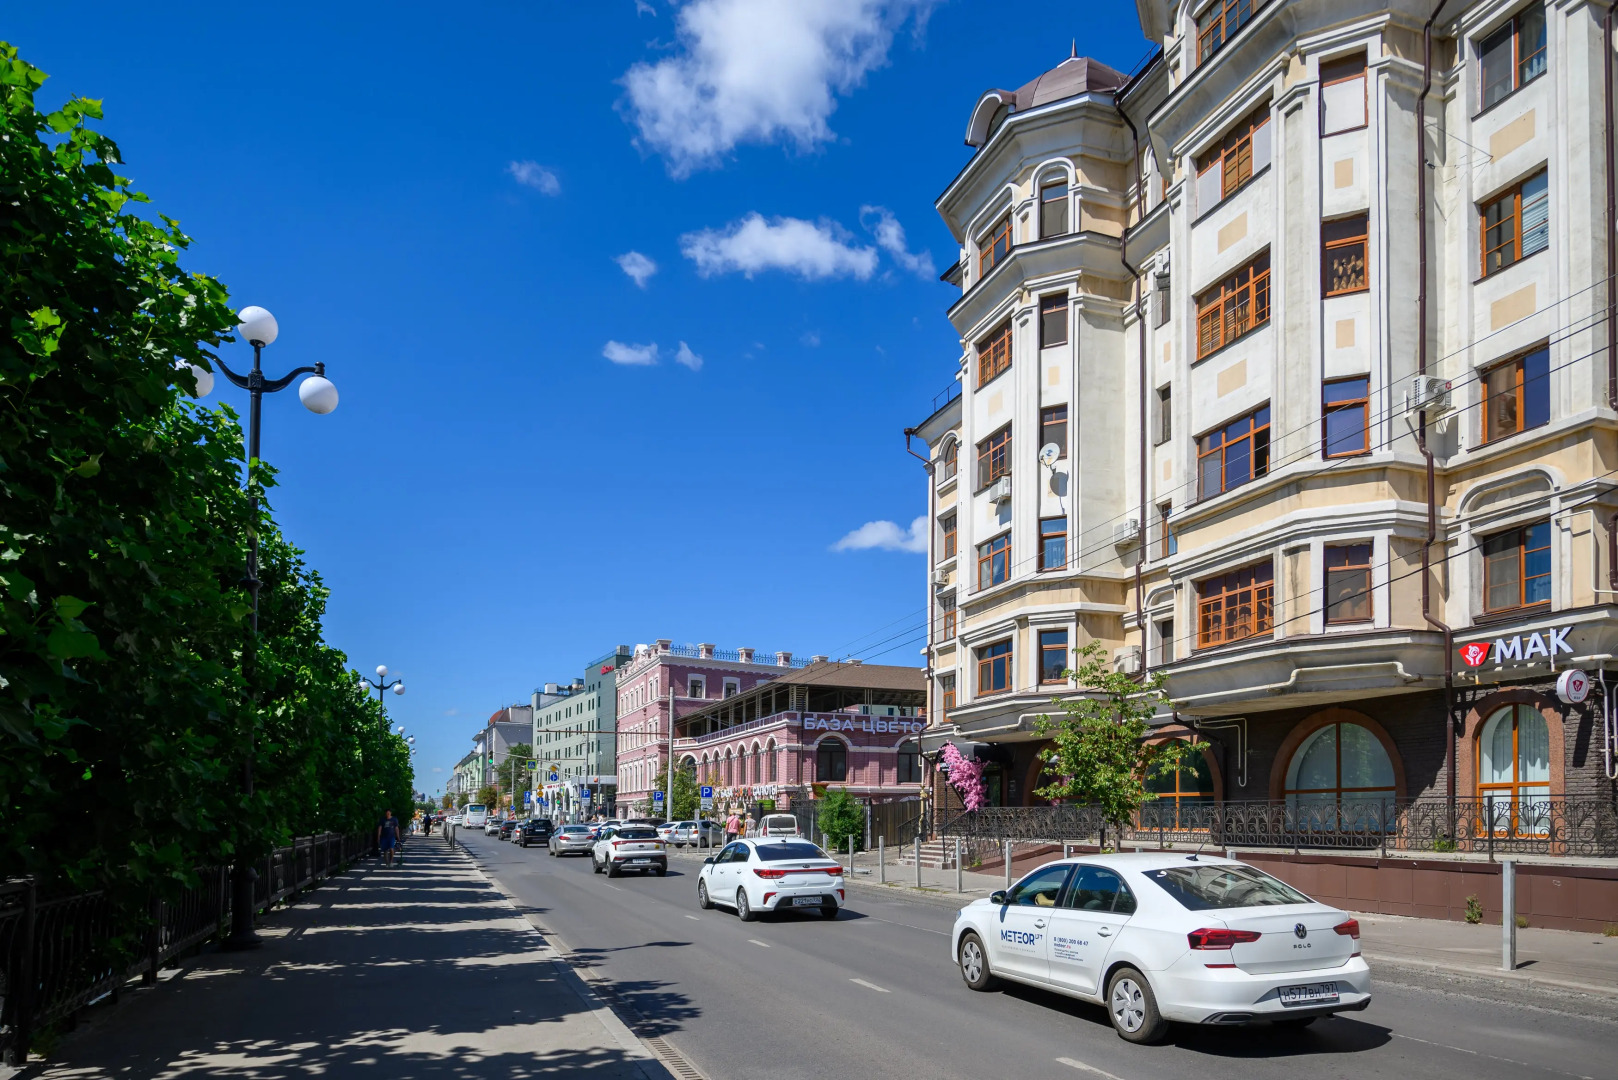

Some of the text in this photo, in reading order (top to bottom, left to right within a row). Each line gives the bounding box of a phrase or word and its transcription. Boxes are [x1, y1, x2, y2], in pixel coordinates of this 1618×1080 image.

[1495, 626, 1574, 664] МАК
[804, 717, 926, 734] БАЗА ЦВЕТО
[1001, 930, 1035, 945] METEOR
